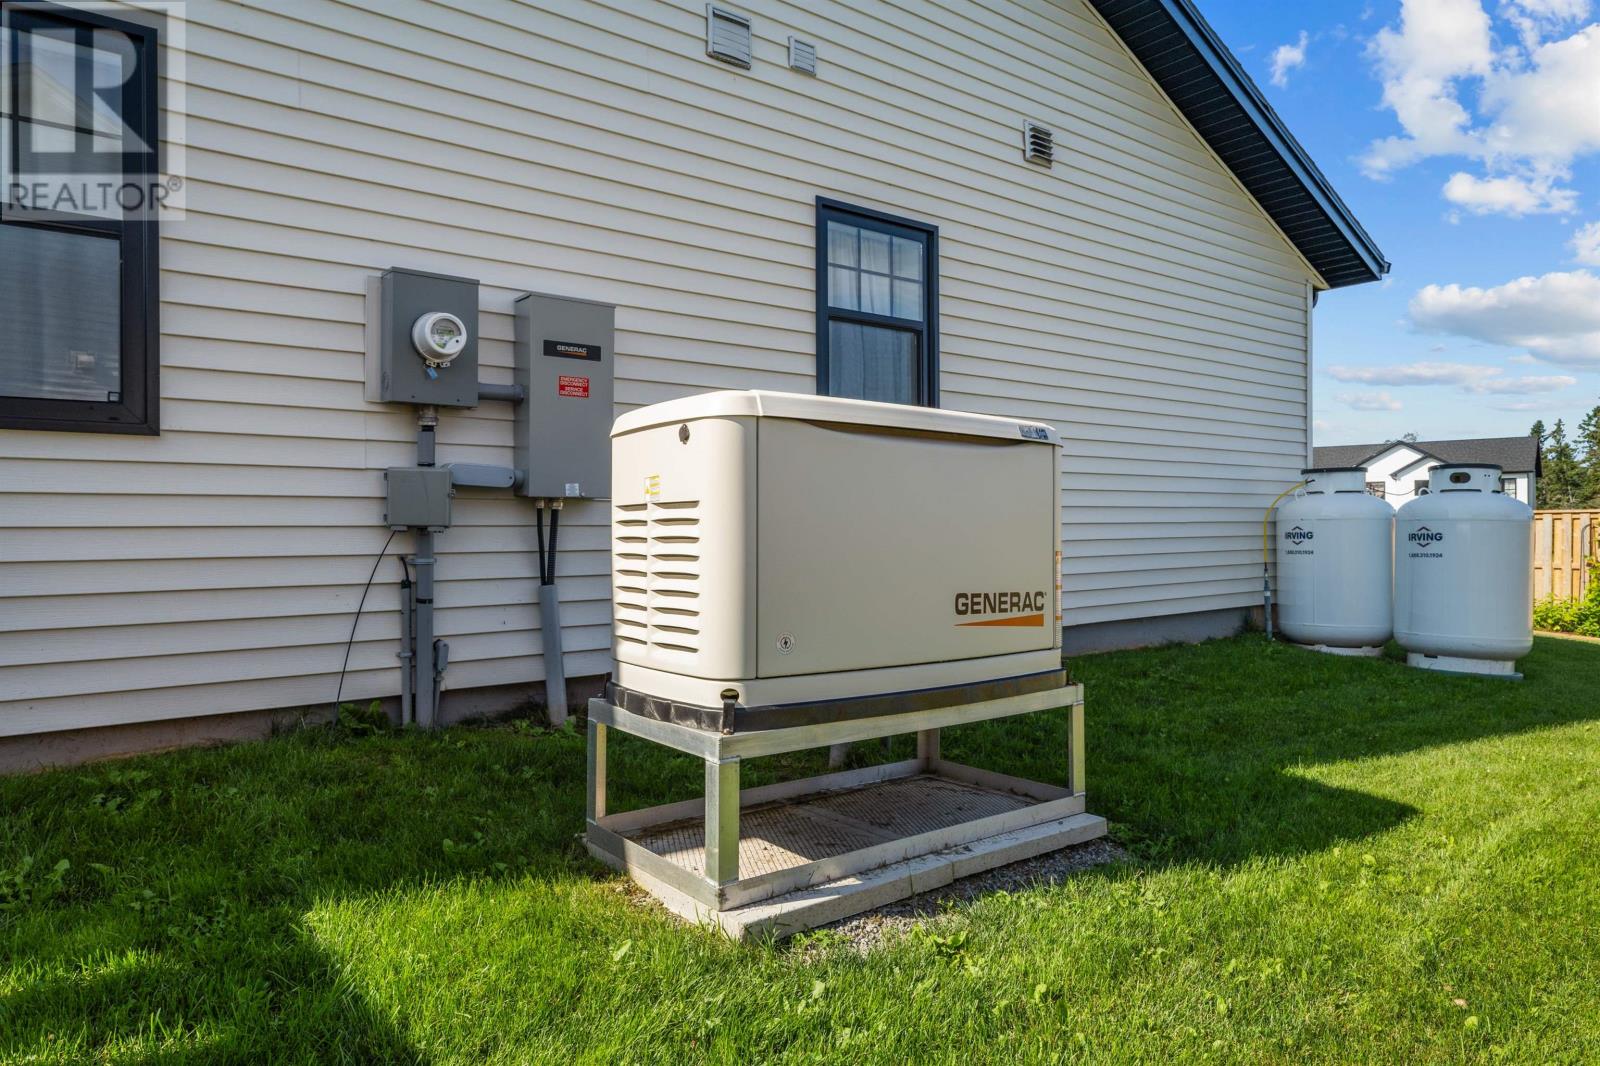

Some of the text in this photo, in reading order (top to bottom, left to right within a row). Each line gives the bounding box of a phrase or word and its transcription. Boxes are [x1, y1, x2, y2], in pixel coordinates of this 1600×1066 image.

[556, 345, 588, 353] GENERAC
[1284, 531, 1314, 540] IRVING
[1408, 532, 1443, 541] IRVING
[954, 591, 1045, 615] GENERAC
